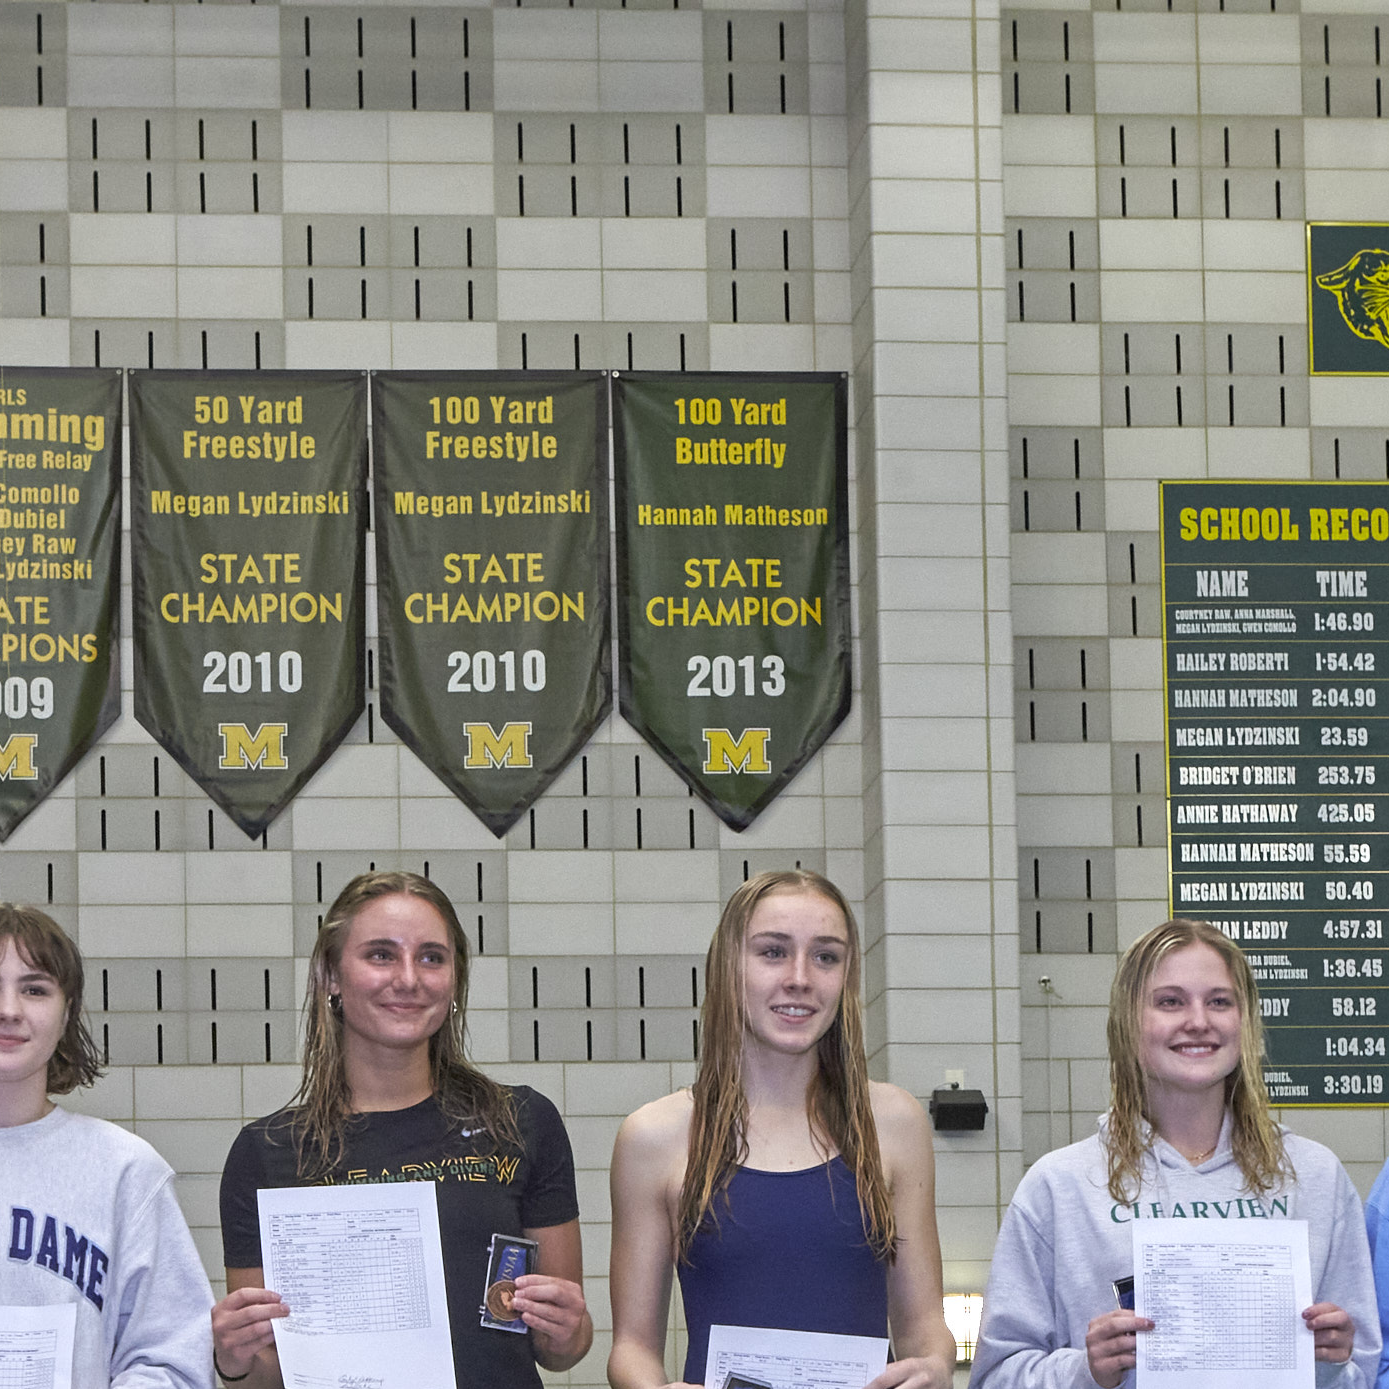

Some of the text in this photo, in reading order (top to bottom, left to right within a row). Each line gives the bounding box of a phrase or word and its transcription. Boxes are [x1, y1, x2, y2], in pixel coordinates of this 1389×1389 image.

[195, 396, 302, 424] 50 Yard
[675, 398, 786, 425] 100 Yard
[184, 431, 315, 462] Freestyle
[676, 437, 786, 468] Butterfly
[152, 491, 348, 517] Megan Lydzinski
[639, 504, 827, 526] Hannah Matheson
[1180, 507, 1299, 540] SCHOOL
[201, 553, 300, 583] STATE
[444, 553, 543, 583] STATE
[685, 559, 781, 588] STATE
[1197, 571, 1248, 597] NAME
[1316, 571, 1367, 597] TIME
[161, 592, 342, 623] CHAMPION
[405, 590, 584, 623] CHAMPION
[646, 597, 821, 626] CHAMPION
[203, 651, 302, 693] 2010
[448, 650, 546, 692] 2010
[687, 655, 785, 697] 2013
[1175, 690, 1225, 707] HANNAH
[1229, 689, 1297, 707] MATHESON
[1312, 688, 1375, 706] 2:04.90
[217, 722, 288, 769] M
[702, 727, 772, 775] M
[1176, 728, 1223, 746] MEGAN
[1227, 727, 1299, 745] LYDZINSKI
[1321, 727, 1367, 746] 23.59
[1244, 921, 1288, 939] LEDDY
[1324, 920, 1382, 938] 4:57.31
[8, 1205, 109, 1312] DAME
